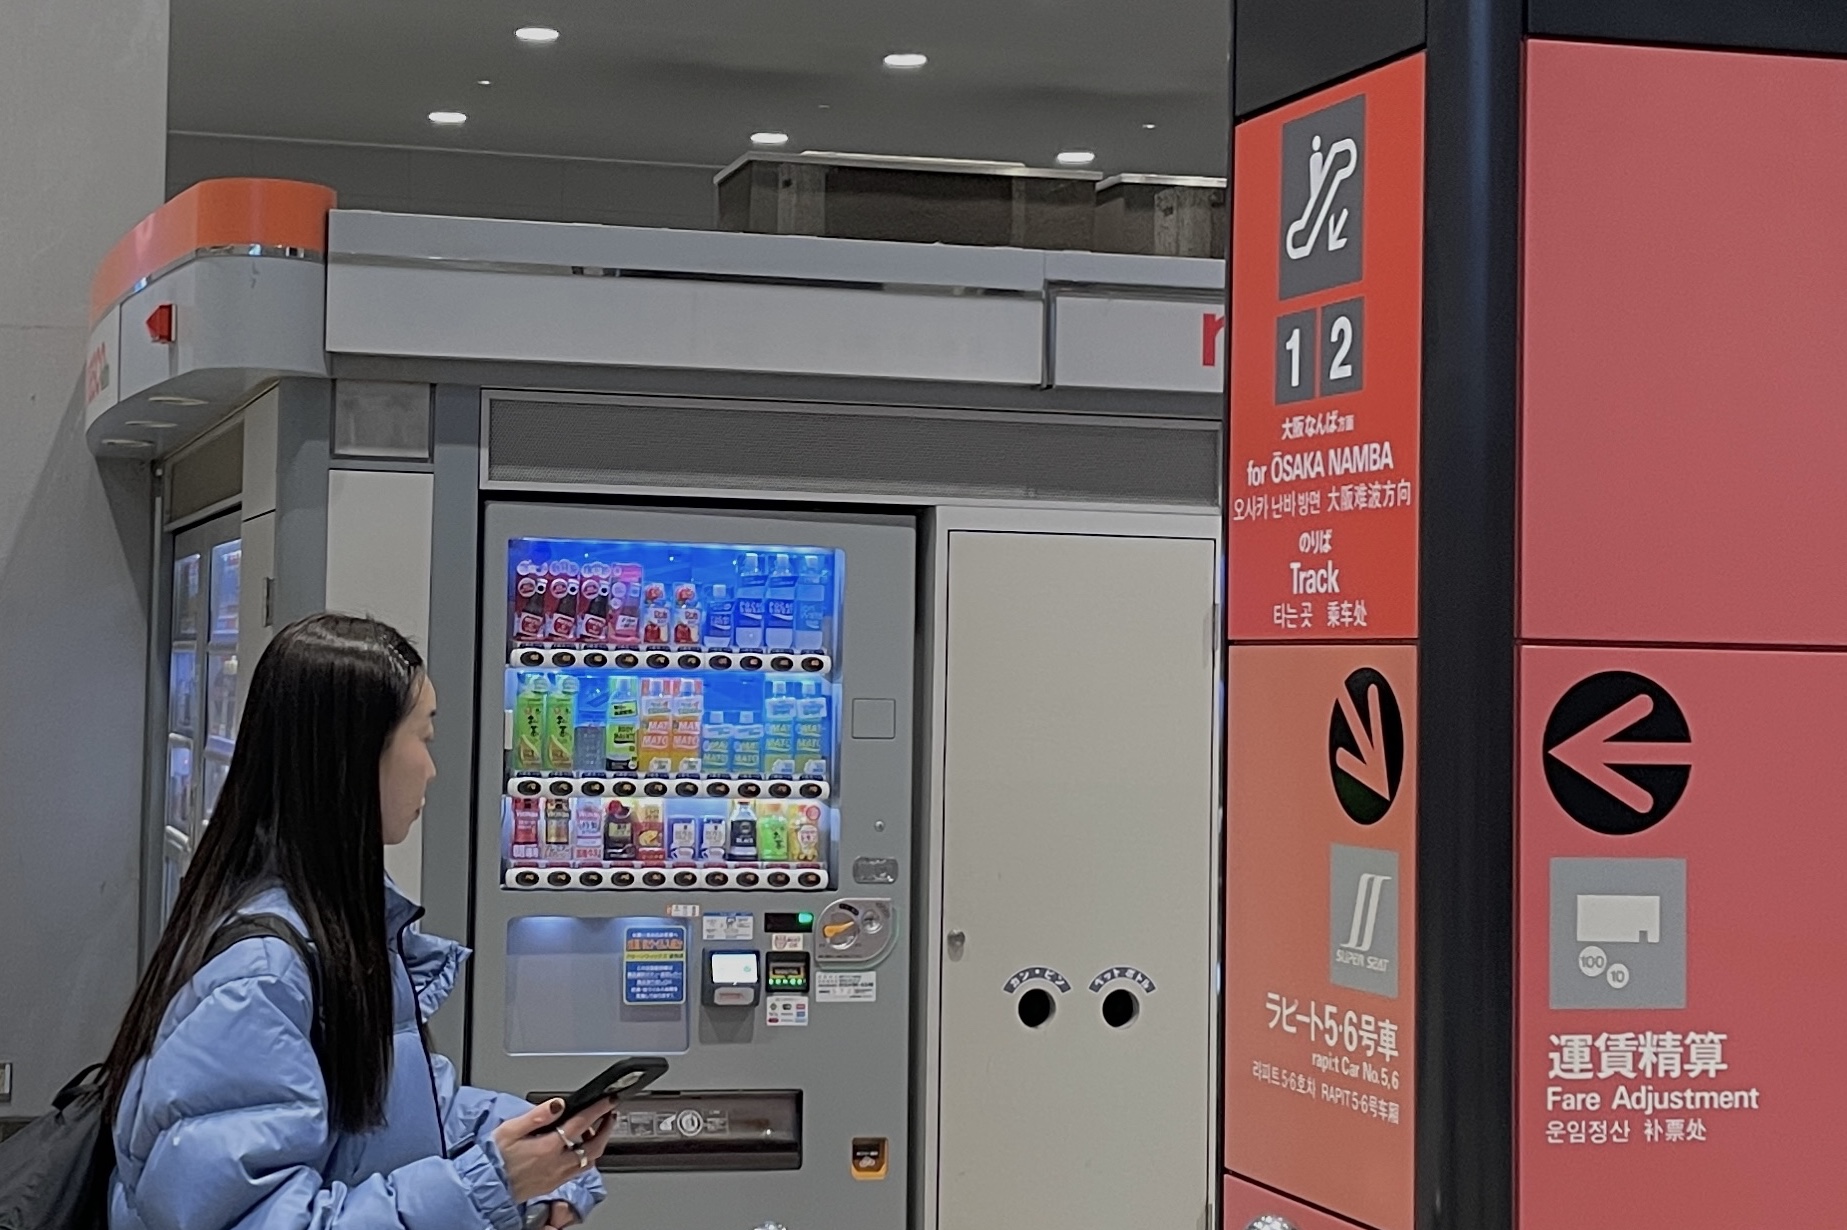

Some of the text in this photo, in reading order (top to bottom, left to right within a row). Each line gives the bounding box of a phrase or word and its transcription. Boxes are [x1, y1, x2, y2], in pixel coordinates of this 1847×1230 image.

[1286, 316, 1353, 387] 1 2
[1247, 441, 1394, 486] for ŌSAKA NAMBA
[1233, 495, 1268, 521] 오사카
[1299, 528, 1333, 554] のりば
[1289, 560, 1340, 594] Track
[1335, 949, 1390, 972] SUPER SEAT
[1580, 955, 1605, 968] 100
[1610, 970, 1625, 982] 10
[1341, 1056, 1360, 1078] Car
[1548, 1030, 1728, 1080] 運賃精算
[1546, 1085, 1760, 1115] Fare Adjustment
[1545, 1120, 1631, 1144] 운임정산
[1644, 1118, 1707, 1142] 补票处
